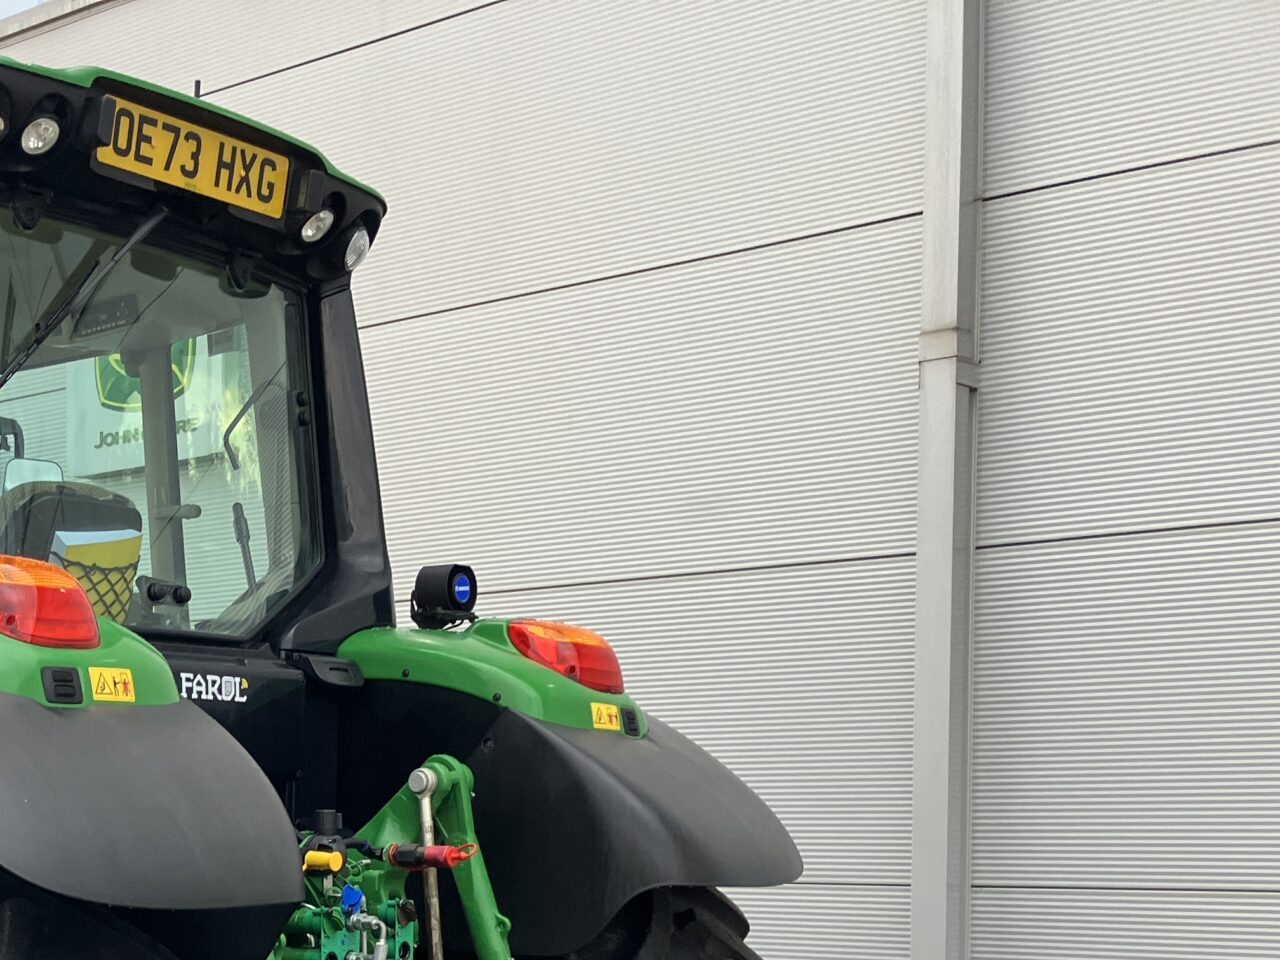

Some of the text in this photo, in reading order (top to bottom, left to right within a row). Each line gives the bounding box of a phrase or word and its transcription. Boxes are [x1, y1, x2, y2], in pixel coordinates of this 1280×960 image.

[112, 107, 277, 204] OE73 HXG
[180, 672, 247, 702] FAROL
